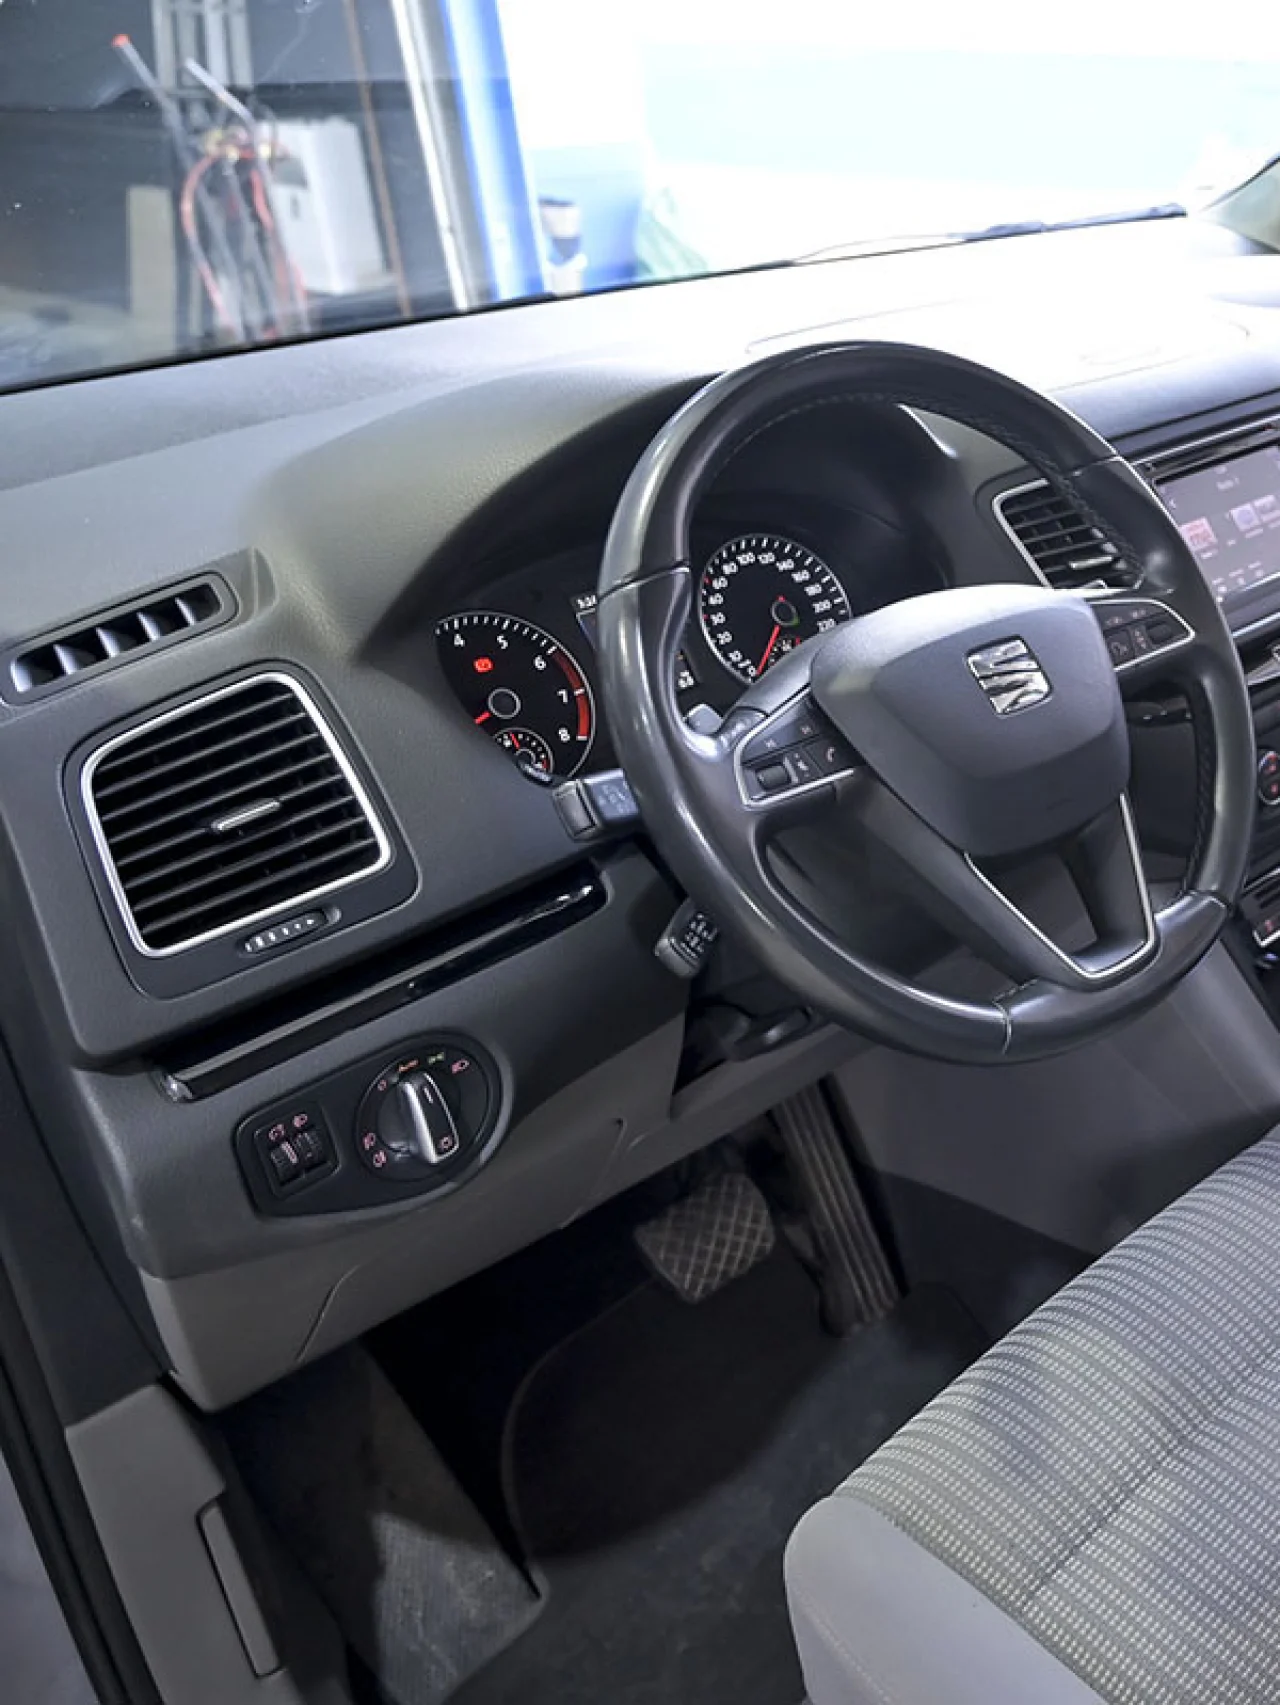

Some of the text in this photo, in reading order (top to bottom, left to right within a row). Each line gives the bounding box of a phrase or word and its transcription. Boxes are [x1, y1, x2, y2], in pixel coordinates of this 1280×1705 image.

[454, 633, 465, 647] 4
[496, 635, 509, 649] 5
[534, 654, 546, 670] 6
[557, 689, 568, 703] 7
[558, 727, 570, 743] 8
